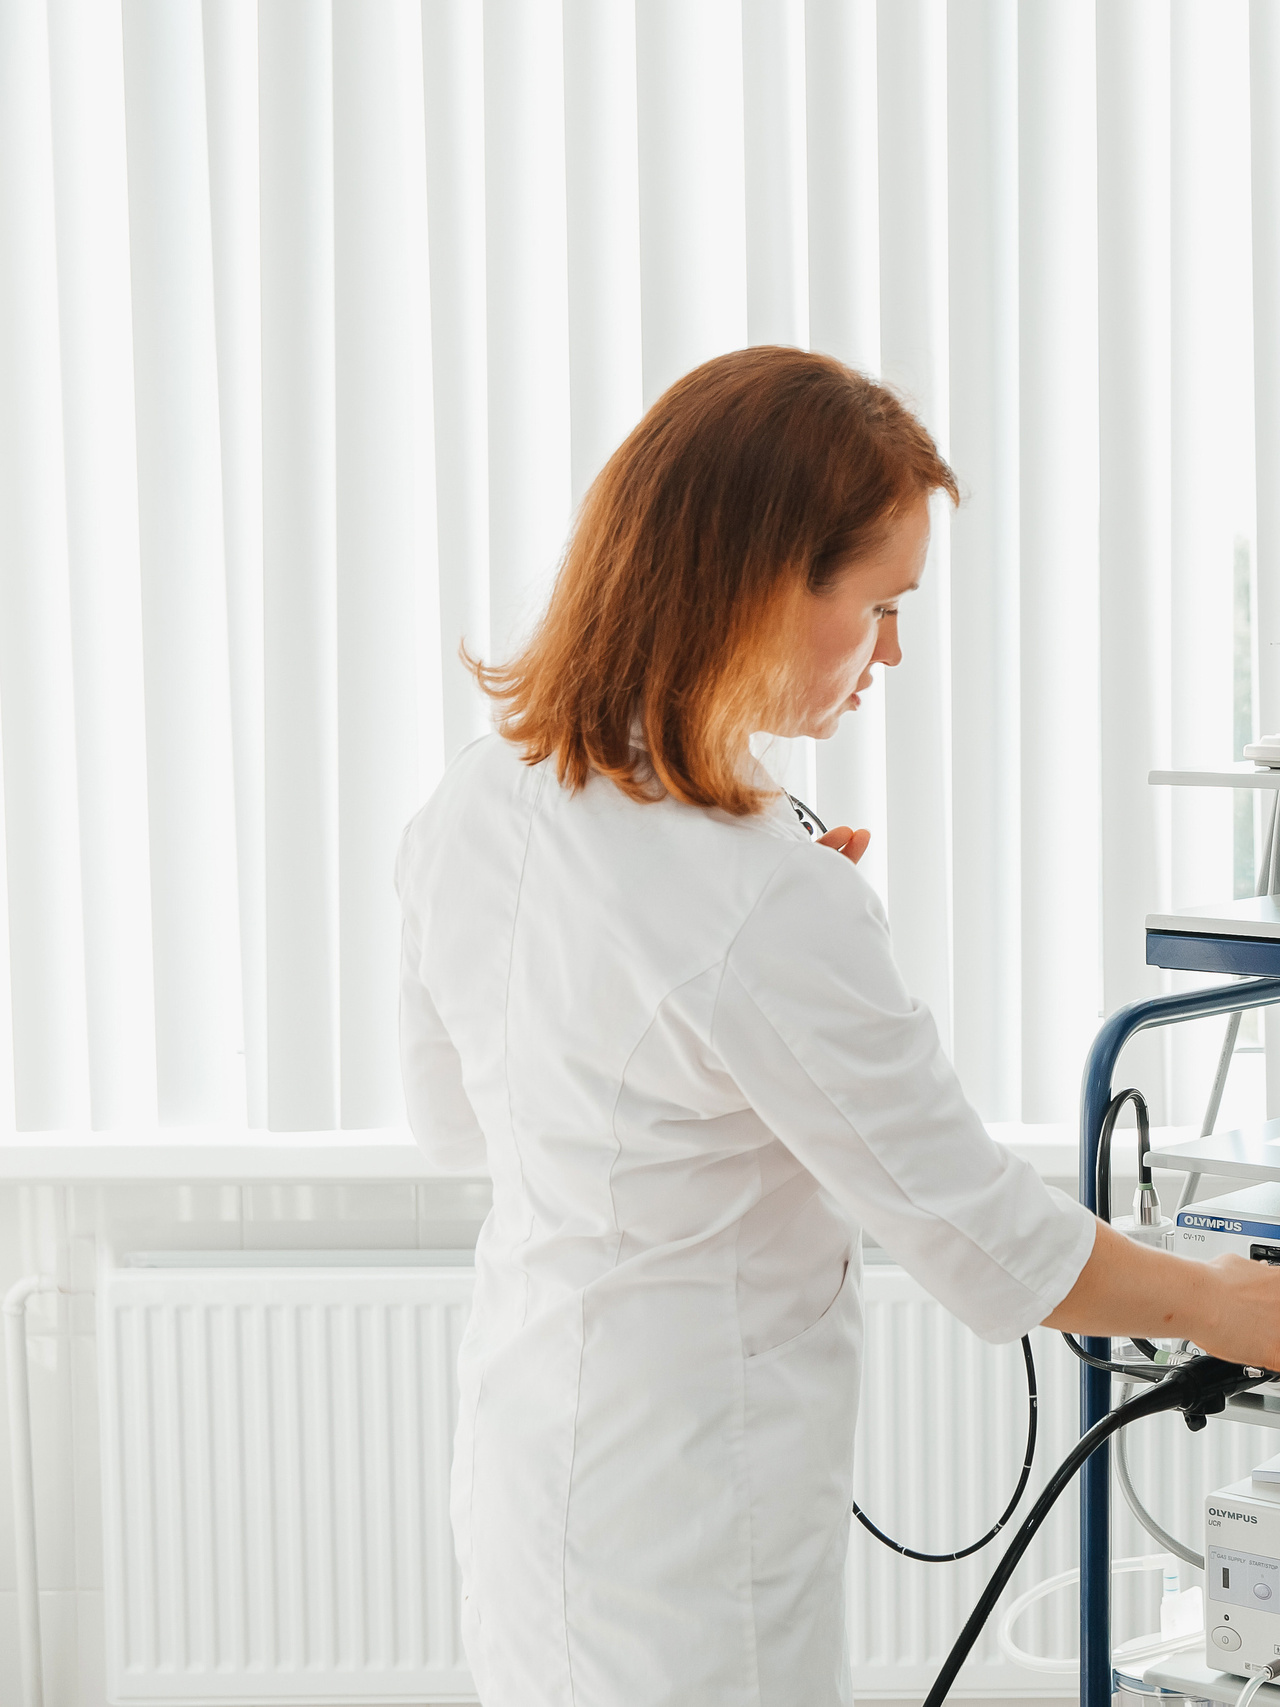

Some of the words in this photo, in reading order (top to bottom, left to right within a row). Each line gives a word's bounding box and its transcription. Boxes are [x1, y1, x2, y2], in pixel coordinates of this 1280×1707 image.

[1184, 1215, 1242, 1232] OLYMPUS
[1183, 1233, 1205, 1242] CV-170
[1208, 1507, 1258, 1525] OLYMPUS
[1208, 1519, 1222, 1527] UCR
[1227, 1555, 1246, 1563] SUPPLY
[1249, 1560, 1279, 1570] START/STOP
